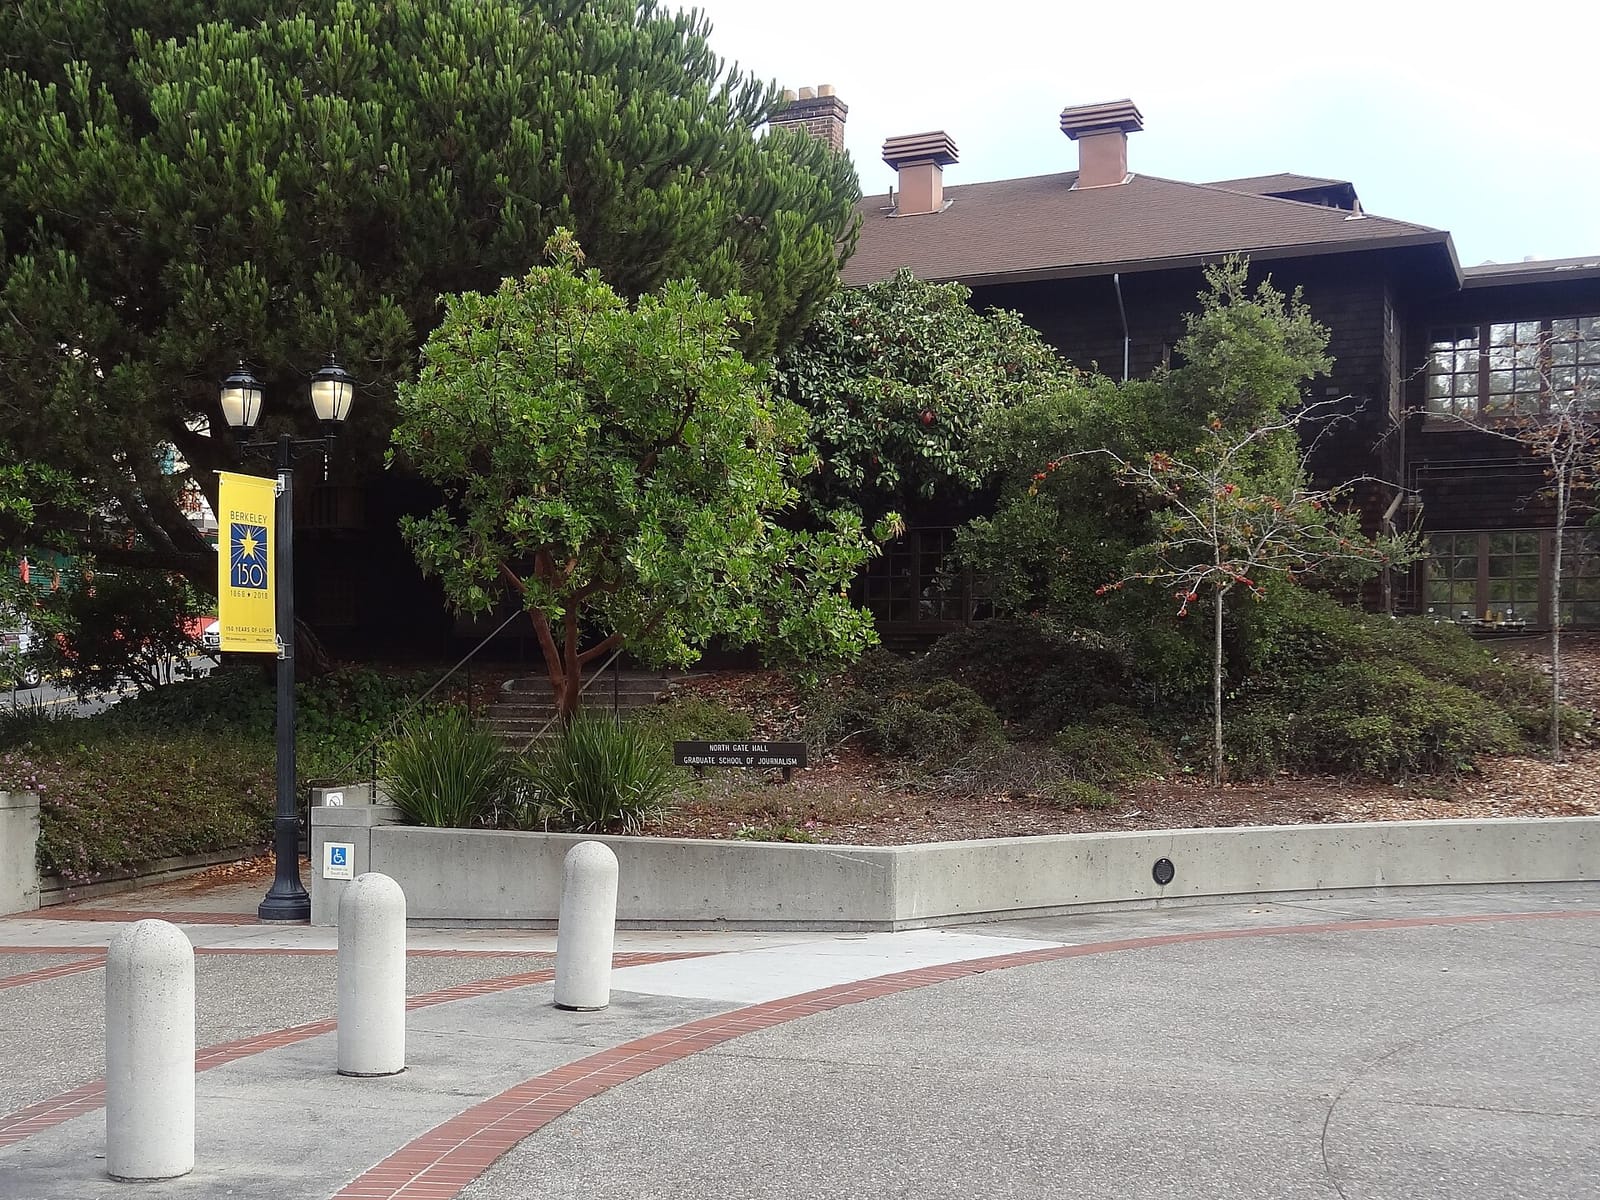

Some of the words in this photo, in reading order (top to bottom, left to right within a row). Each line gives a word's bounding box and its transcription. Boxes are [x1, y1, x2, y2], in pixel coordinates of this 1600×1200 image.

[230, 510, 268, 524] BERKELEY
[237, 563, 263, 586] 150
[230, 590, 246, 598] 1868
[253, 592, 269, 600] 2018
[709, 744, 730, 752] NORTH
[732, 744, 749, 752] GATE
[751, 744, 769, 752] HALL
[683, 756, 716, 765] GRADUATE
[718, 756, 744, 765] SCHOOL
[745, 757, 754, 765] OF
[757, 757, 798, 766] JOURNALISM
